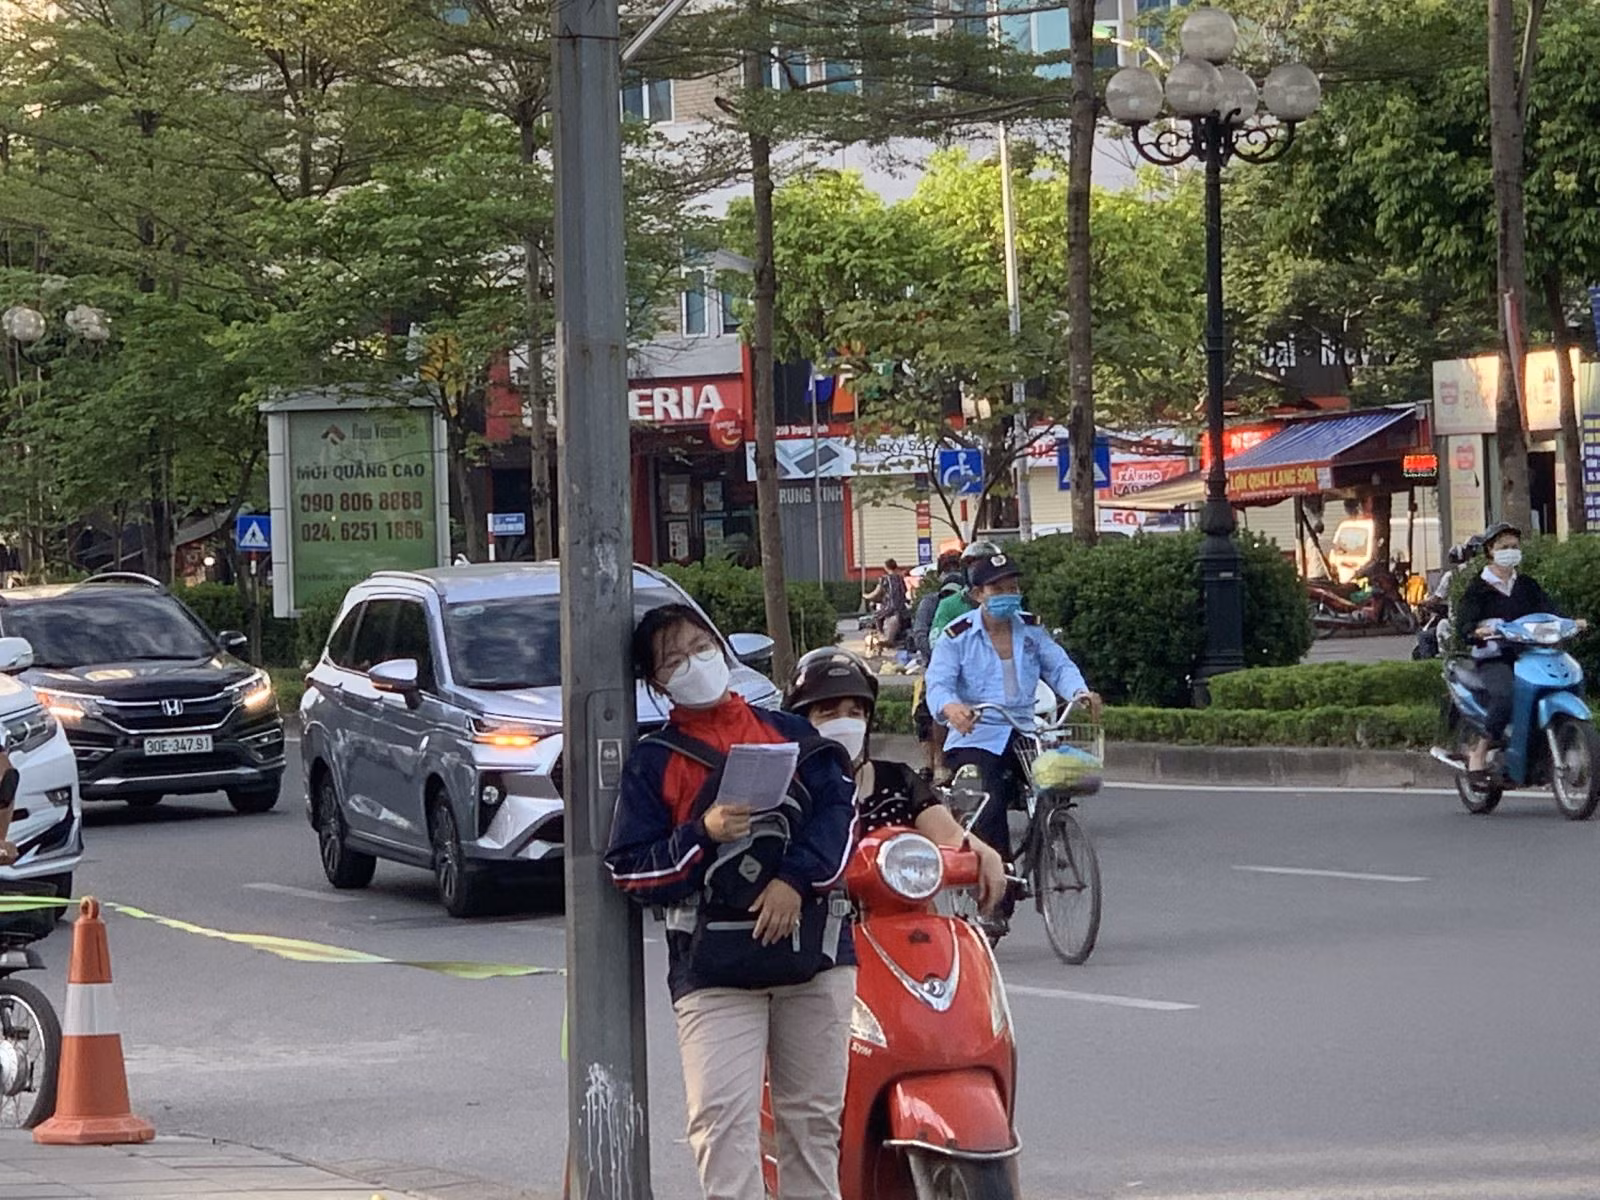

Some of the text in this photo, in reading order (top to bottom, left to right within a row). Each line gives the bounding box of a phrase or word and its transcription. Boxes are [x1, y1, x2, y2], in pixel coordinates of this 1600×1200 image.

[301, 493, 333, 512] 090
[340, 492, 373, 511] 806
[302, 522, 336, 542] 024.
[341, 521, 378, 541] 6251
